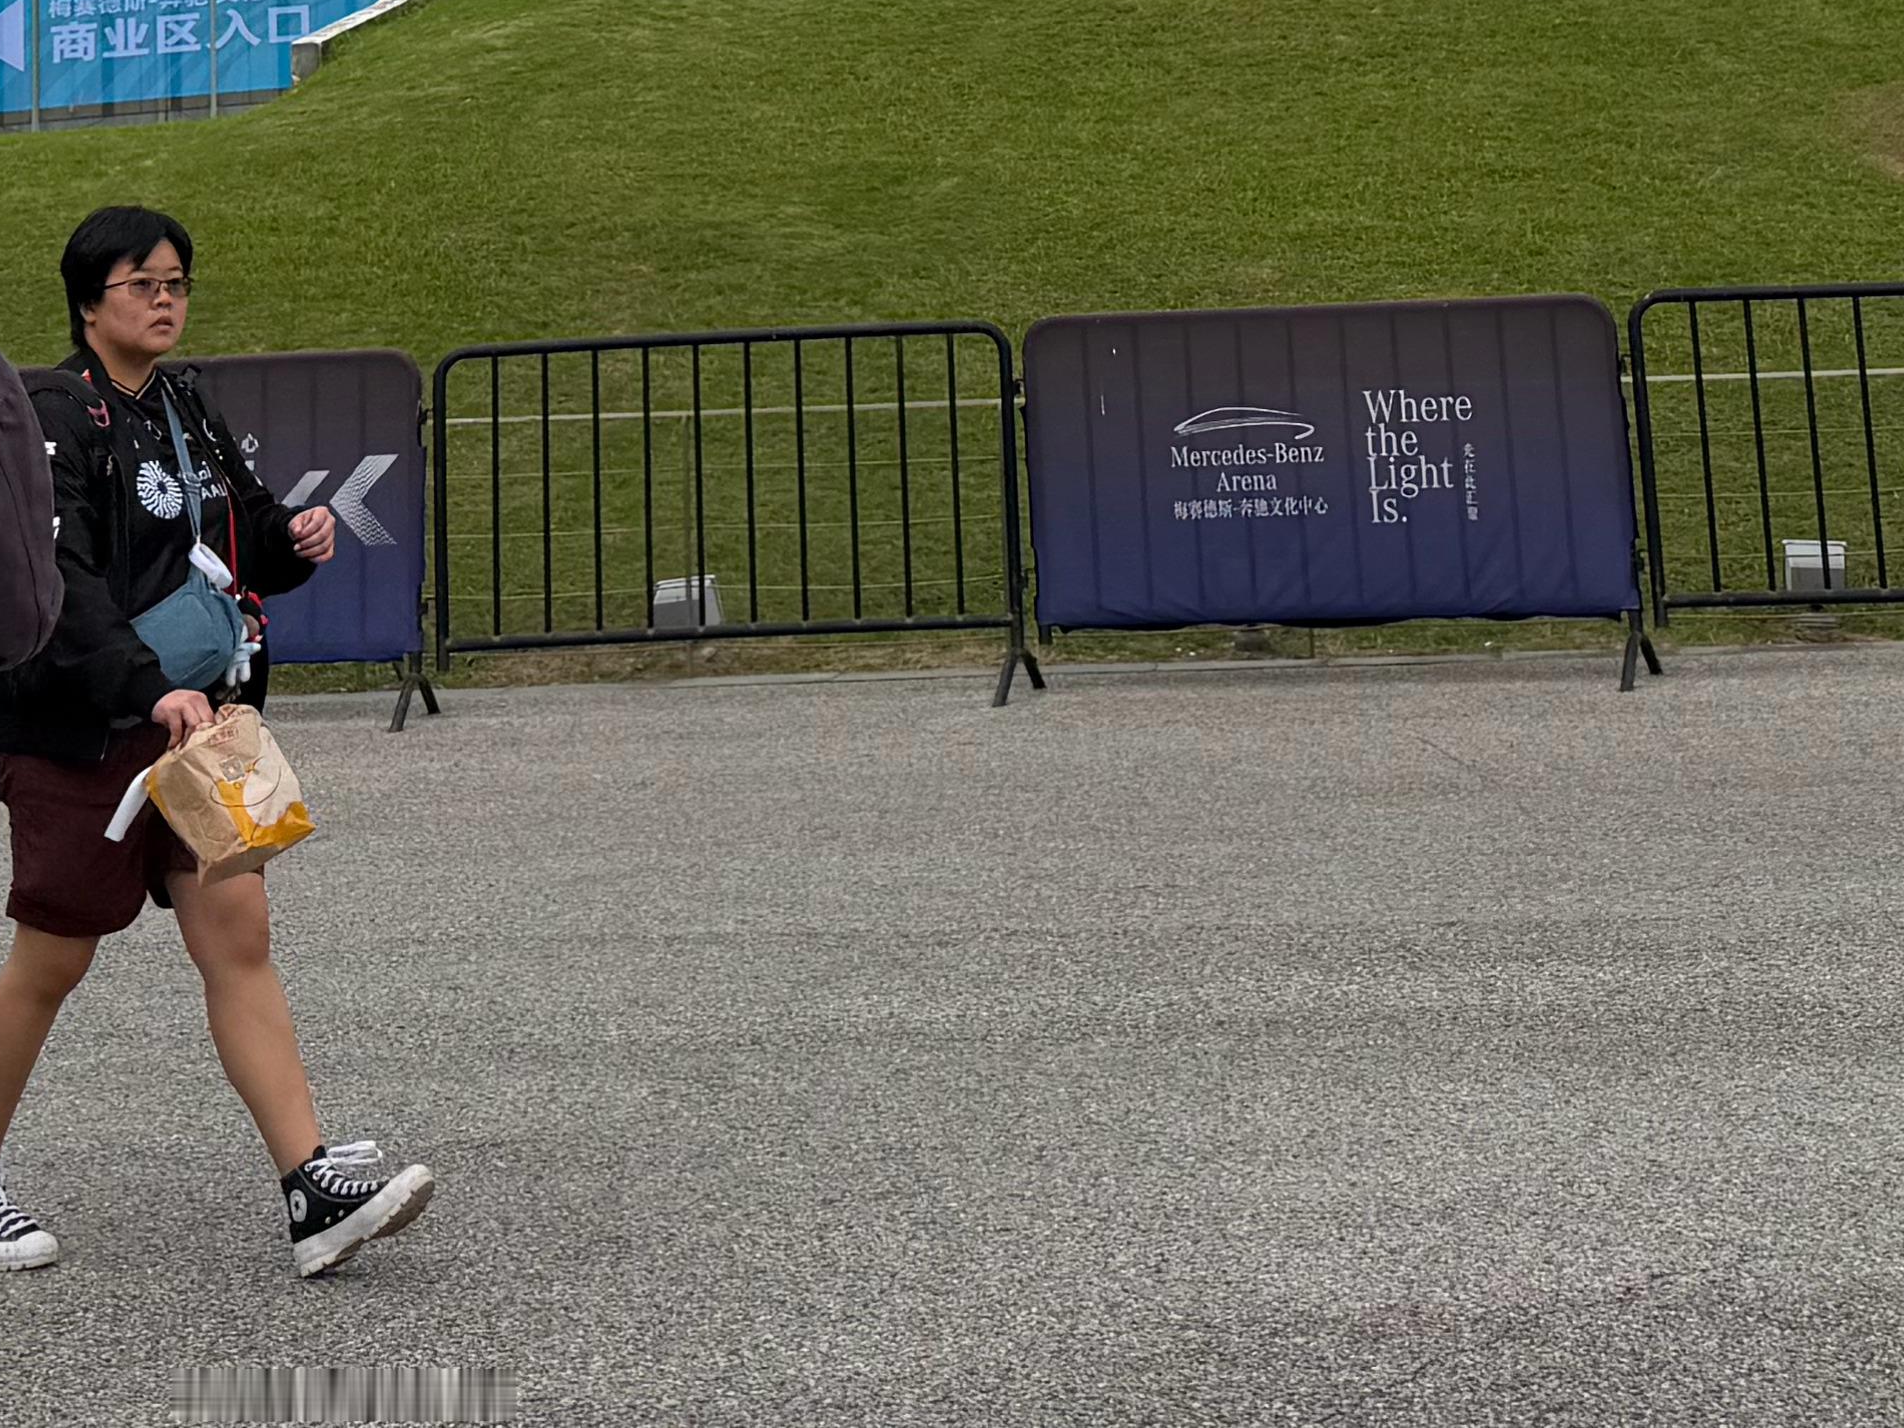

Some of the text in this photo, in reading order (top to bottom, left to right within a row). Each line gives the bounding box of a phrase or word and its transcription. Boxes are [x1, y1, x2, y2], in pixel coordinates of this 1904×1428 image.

[50, 4, 311, 64] 商业区入口
[1362, 389, 1473, 424] Where
[1171, 443, 1324, 468] Mercedes-Benz
[1365, 423, 1419, 457] the
[1216, 471, 1278, 492] Arena
[1366, 455, 1455, 498] Light
[1369, 489, 1408, 523] Is.
